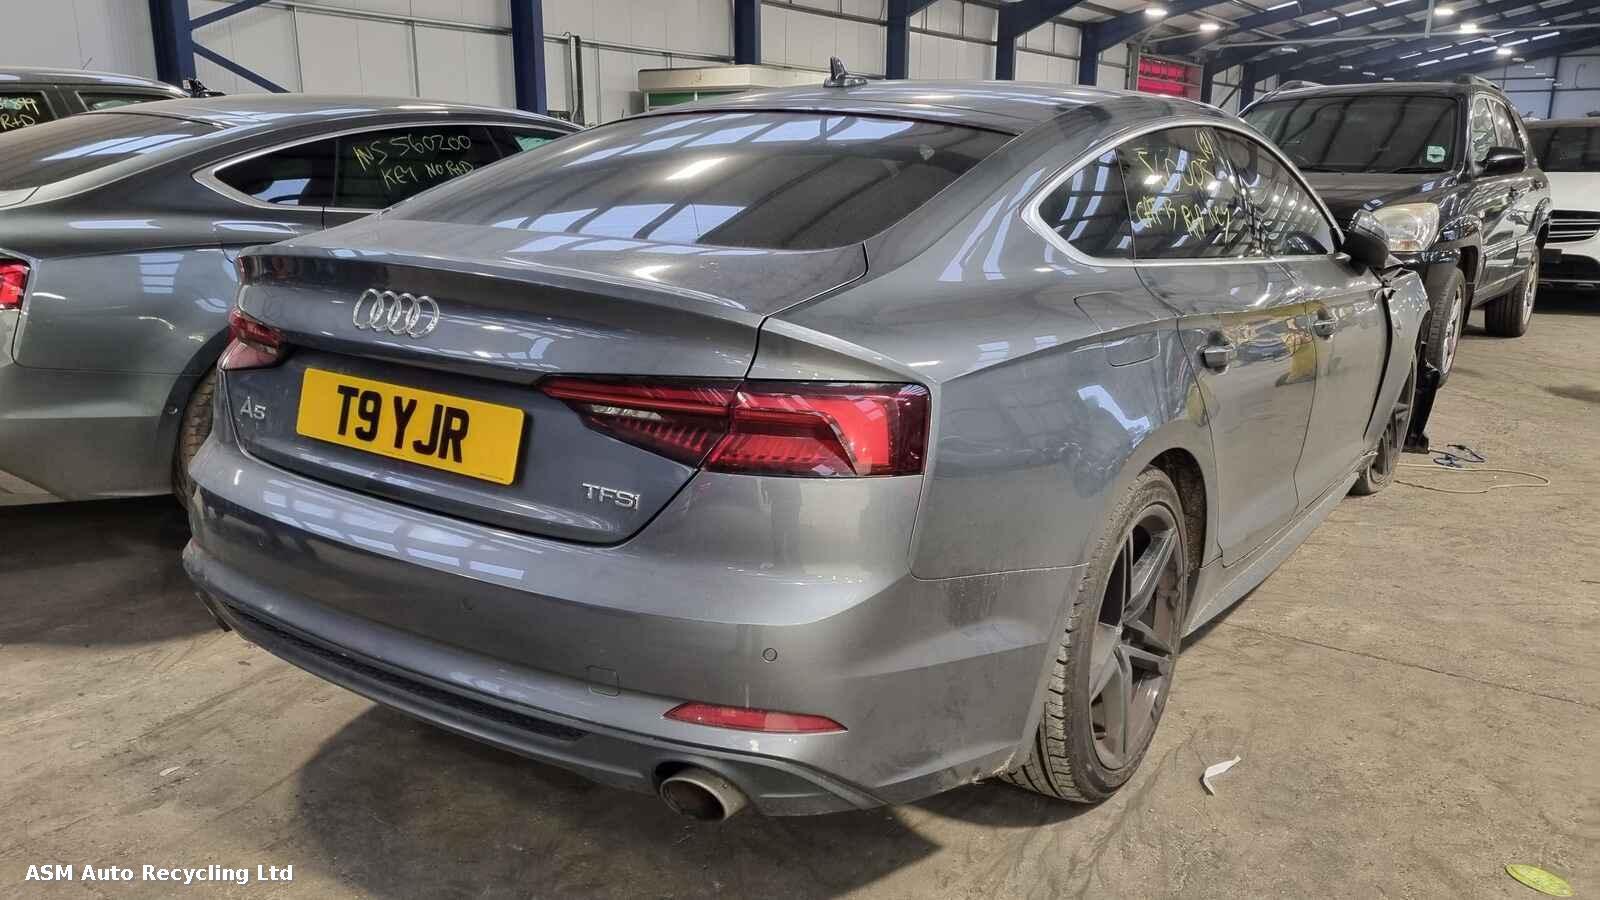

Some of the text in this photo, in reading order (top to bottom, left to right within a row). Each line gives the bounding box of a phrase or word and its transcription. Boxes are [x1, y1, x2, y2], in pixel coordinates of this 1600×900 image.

[240, 396, 266, 420] A5
[337, 385, 470, 463] T9 YJR
